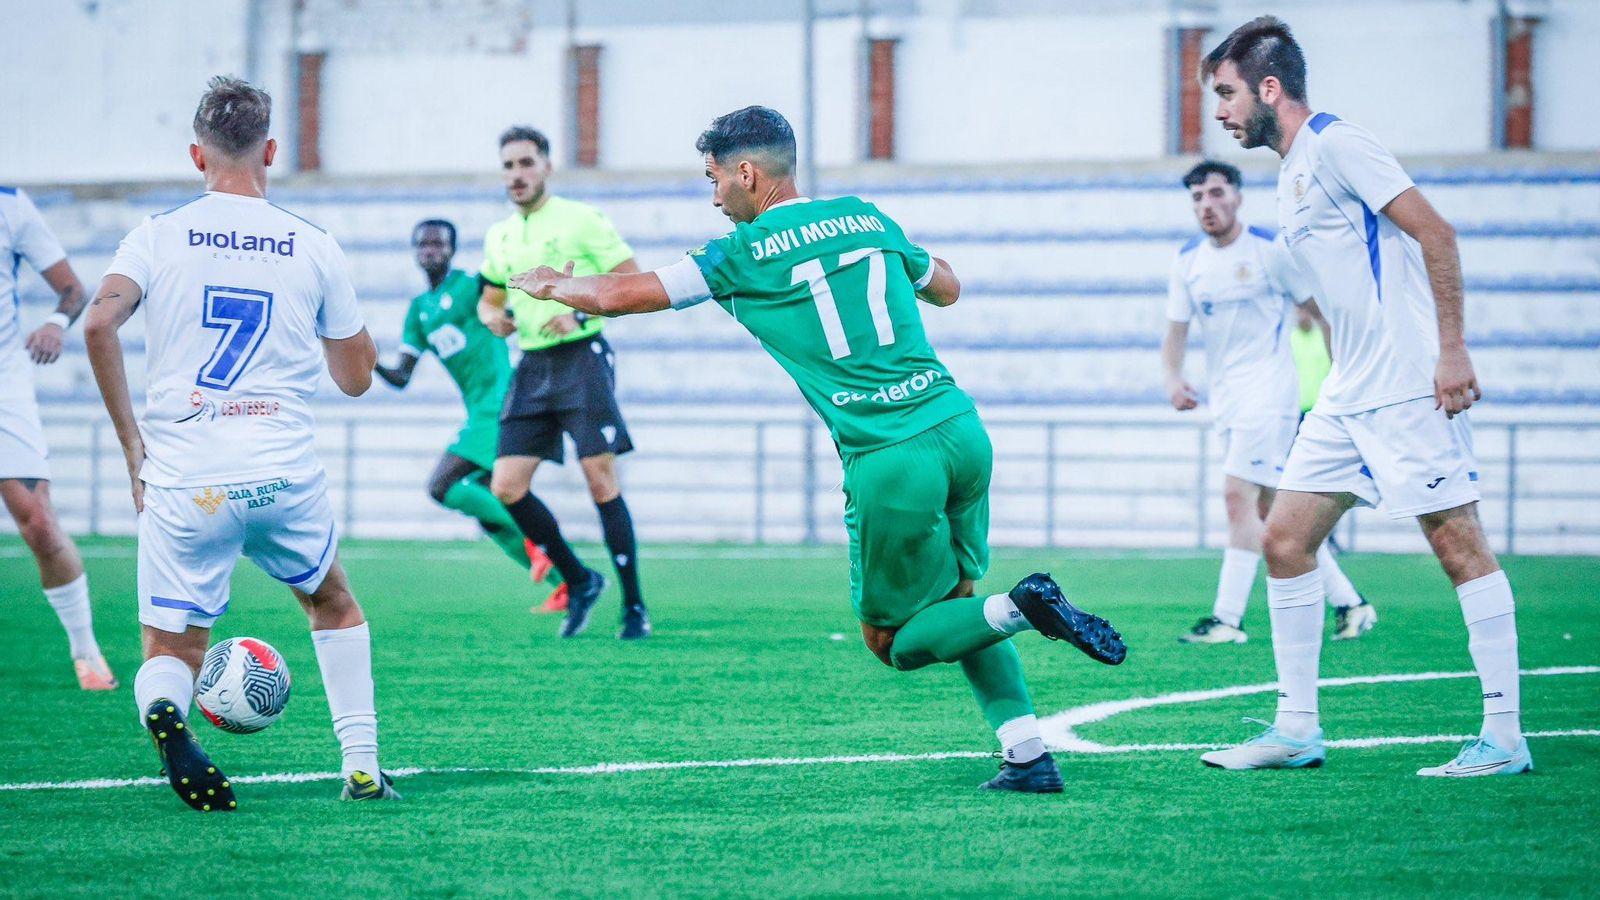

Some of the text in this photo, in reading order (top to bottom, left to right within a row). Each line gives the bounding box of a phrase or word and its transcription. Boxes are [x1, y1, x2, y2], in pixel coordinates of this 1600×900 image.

[188, 229, 295, 257] bioland
[750, 215, 885, 261] JAVI MOYANO
[213, 252, 280, 264] ENERGY
[790, 247, 895, 360] 17
[196, 285, 273, 391] 7
[831, 369, 942, 406] Cderón
[256, 479, 293, 497] RURAL
